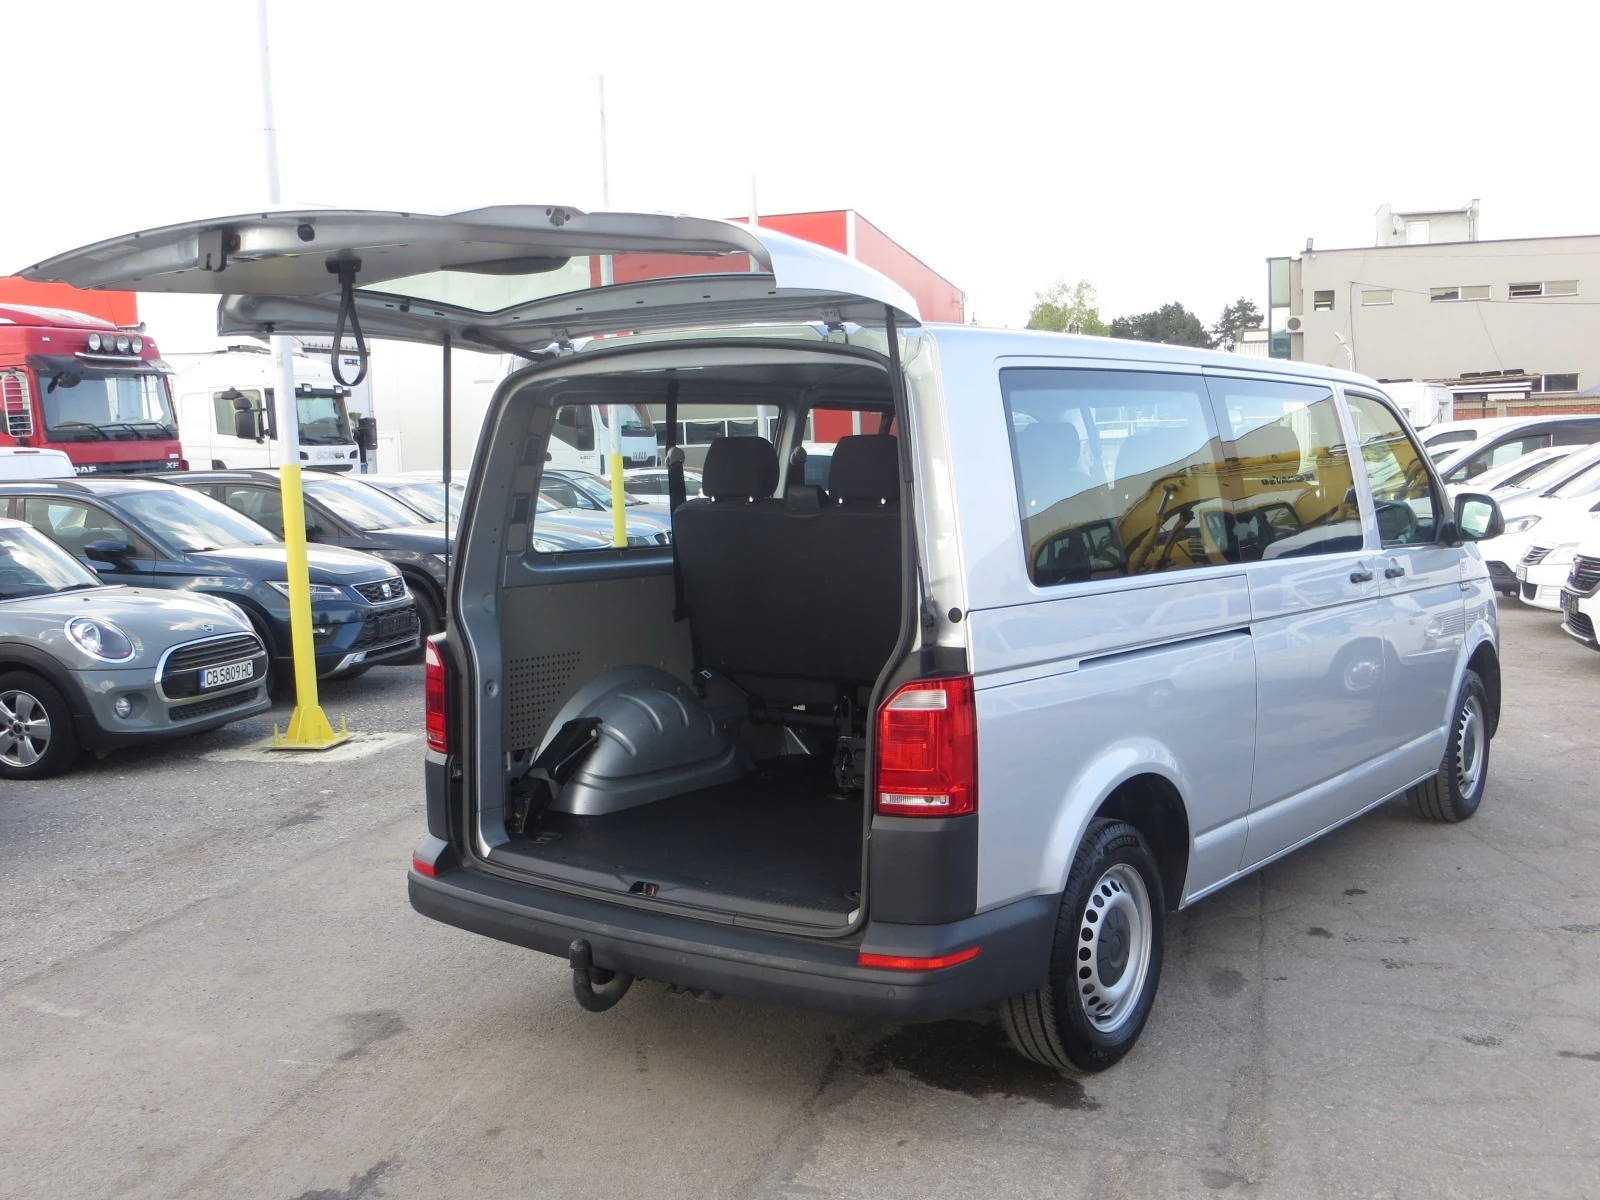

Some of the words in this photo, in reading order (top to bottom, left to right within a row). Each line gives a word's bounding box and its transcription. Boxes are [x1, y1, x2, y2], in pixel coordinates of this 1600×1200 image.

[206, 670, 219, 685] CB
[220, 665, 241, 682] 5809
[242, 662, 252, 678] HC
